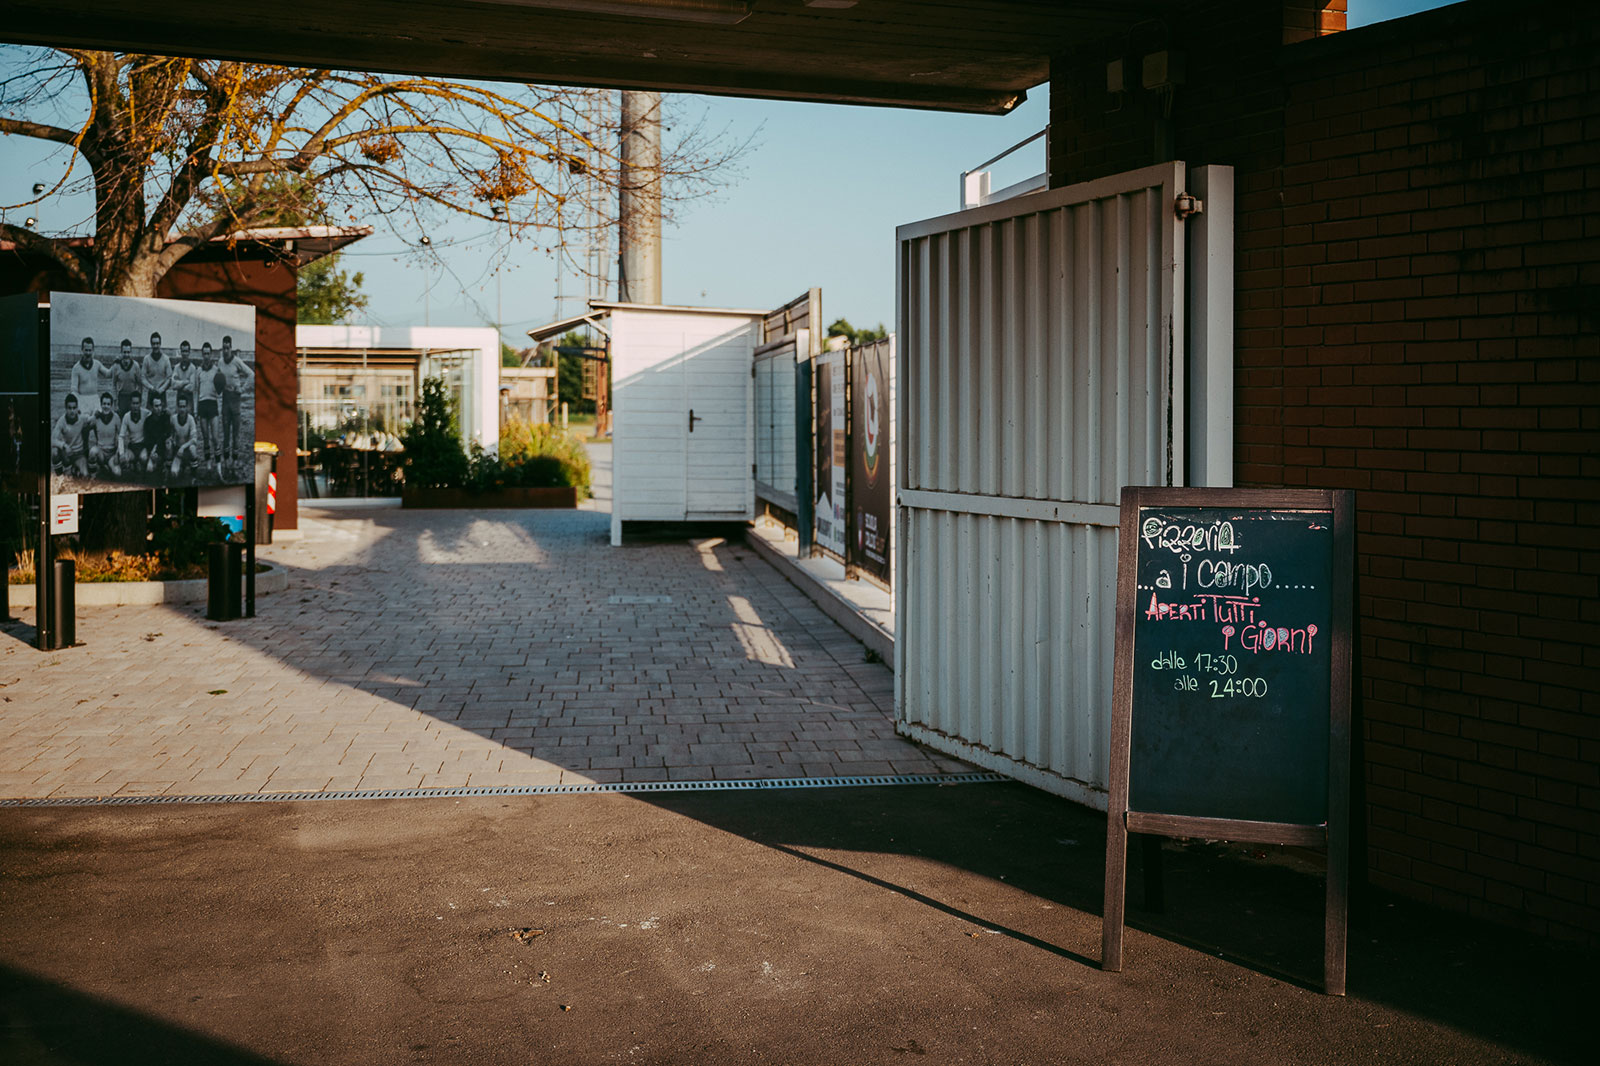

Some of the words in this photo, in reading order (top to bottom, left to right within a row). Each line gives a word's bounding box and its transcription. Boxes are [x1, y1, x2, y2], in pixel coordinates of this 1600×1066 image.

[1151, 650, 1188, 671] dalle
[1193, 652, 1238, 675] 17:30
[1208, 677, 1268, 698] 24:00
